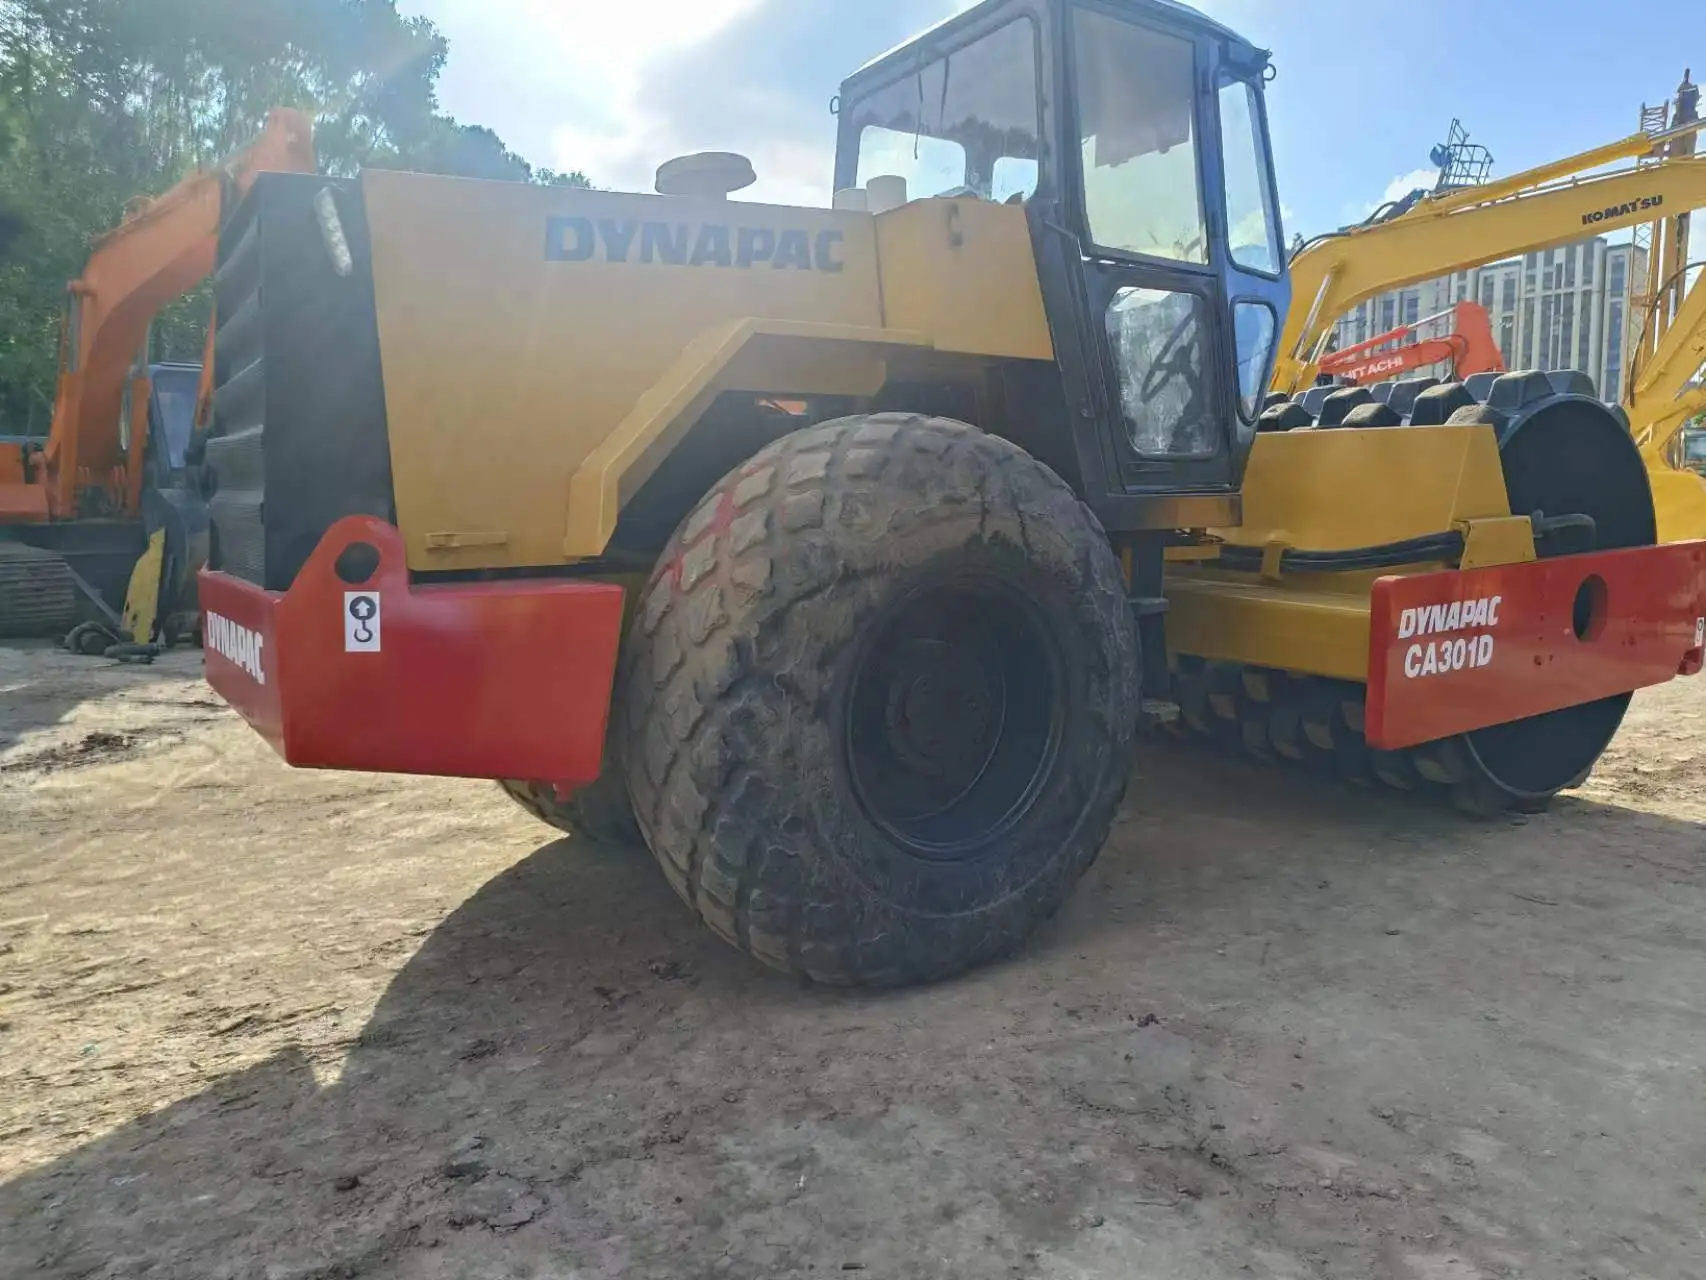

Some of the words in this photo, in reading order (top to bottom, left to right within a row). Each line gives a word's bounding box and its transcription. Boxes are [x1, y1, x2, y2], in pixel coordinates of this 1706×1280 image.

[1581, 195, 1663, 225] KOMATSU
[545, 216, 844, 273] DYNAPAC
[1398, 596, 1502, 639] DYNAPAC
[206, 610, 265, 685] DYNAPAC
[1405, 634, 1494, 679] CA301D
